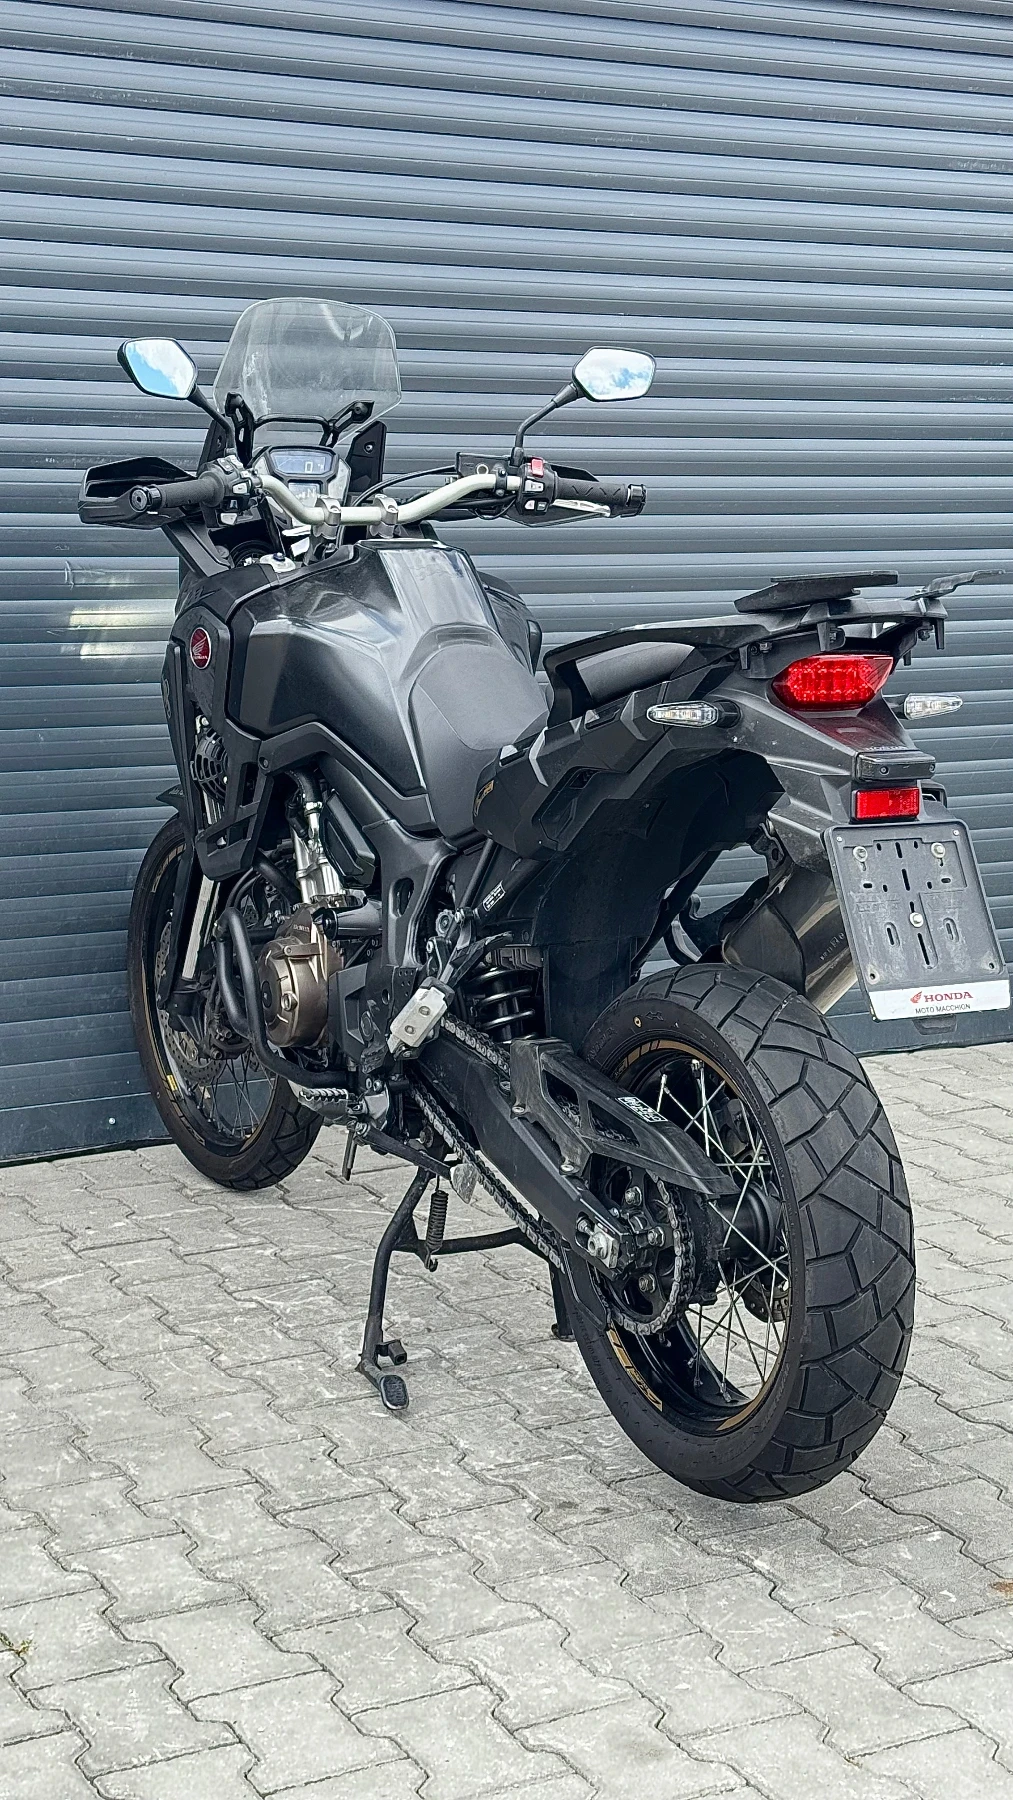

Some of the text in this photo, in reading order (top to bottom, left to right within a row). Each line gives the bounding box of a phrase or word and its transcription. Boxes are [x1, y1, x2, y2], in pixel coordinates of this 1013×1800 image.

[305, 461, 314, 473] 0
[924, 992, 973, 1003] HONDA
[915, 1003, 971, 1015] MOTO MACCHION
